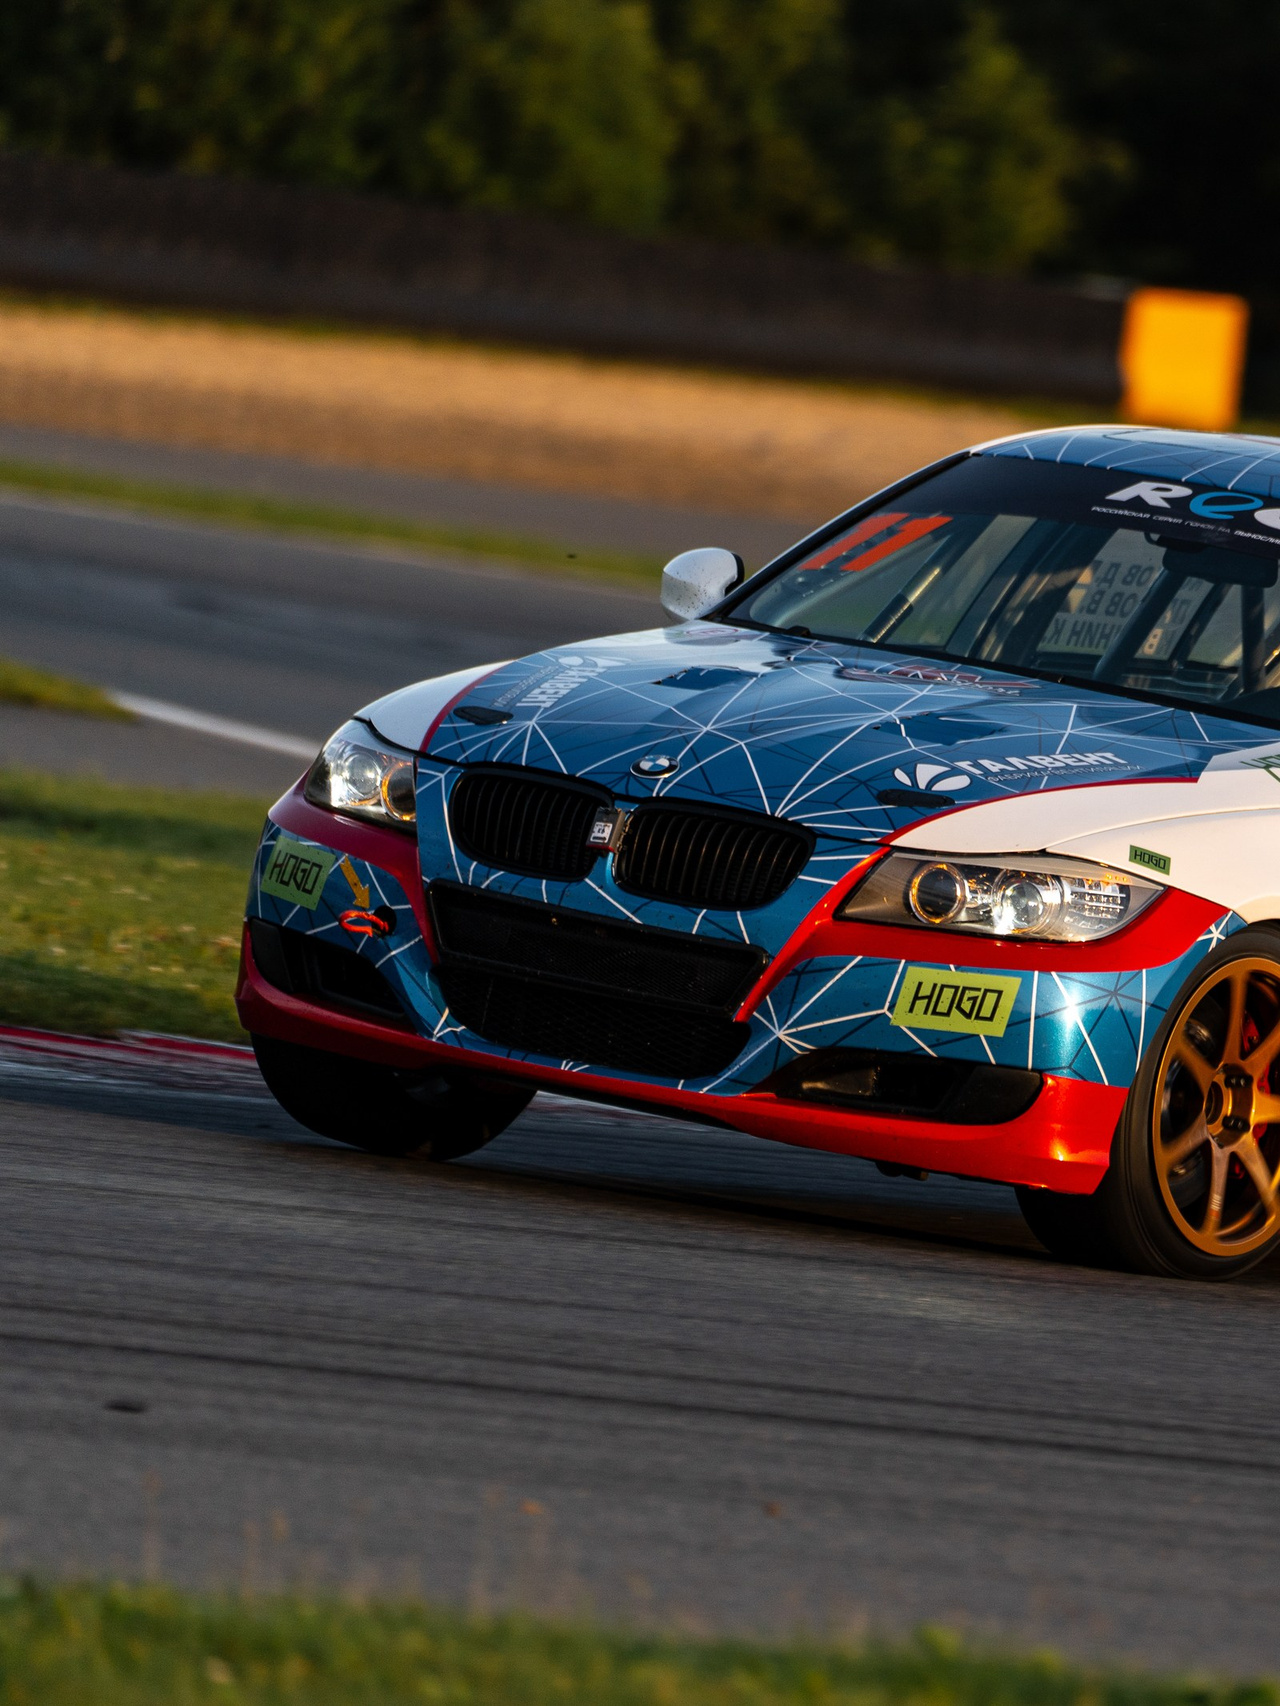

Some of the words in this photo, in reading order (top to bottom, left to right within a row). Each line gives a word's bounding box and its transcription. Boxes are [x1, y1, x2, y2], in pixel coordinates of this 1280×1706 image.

[797, 512, 953, 572] 11
[953, 752, 1129, 775] ГАЛВЕНТ
[268, 849, 323, 895] HOGO
[1134, 849, 1167, 870] HOGO
[908, 981, 1004, 1022] HOGO
